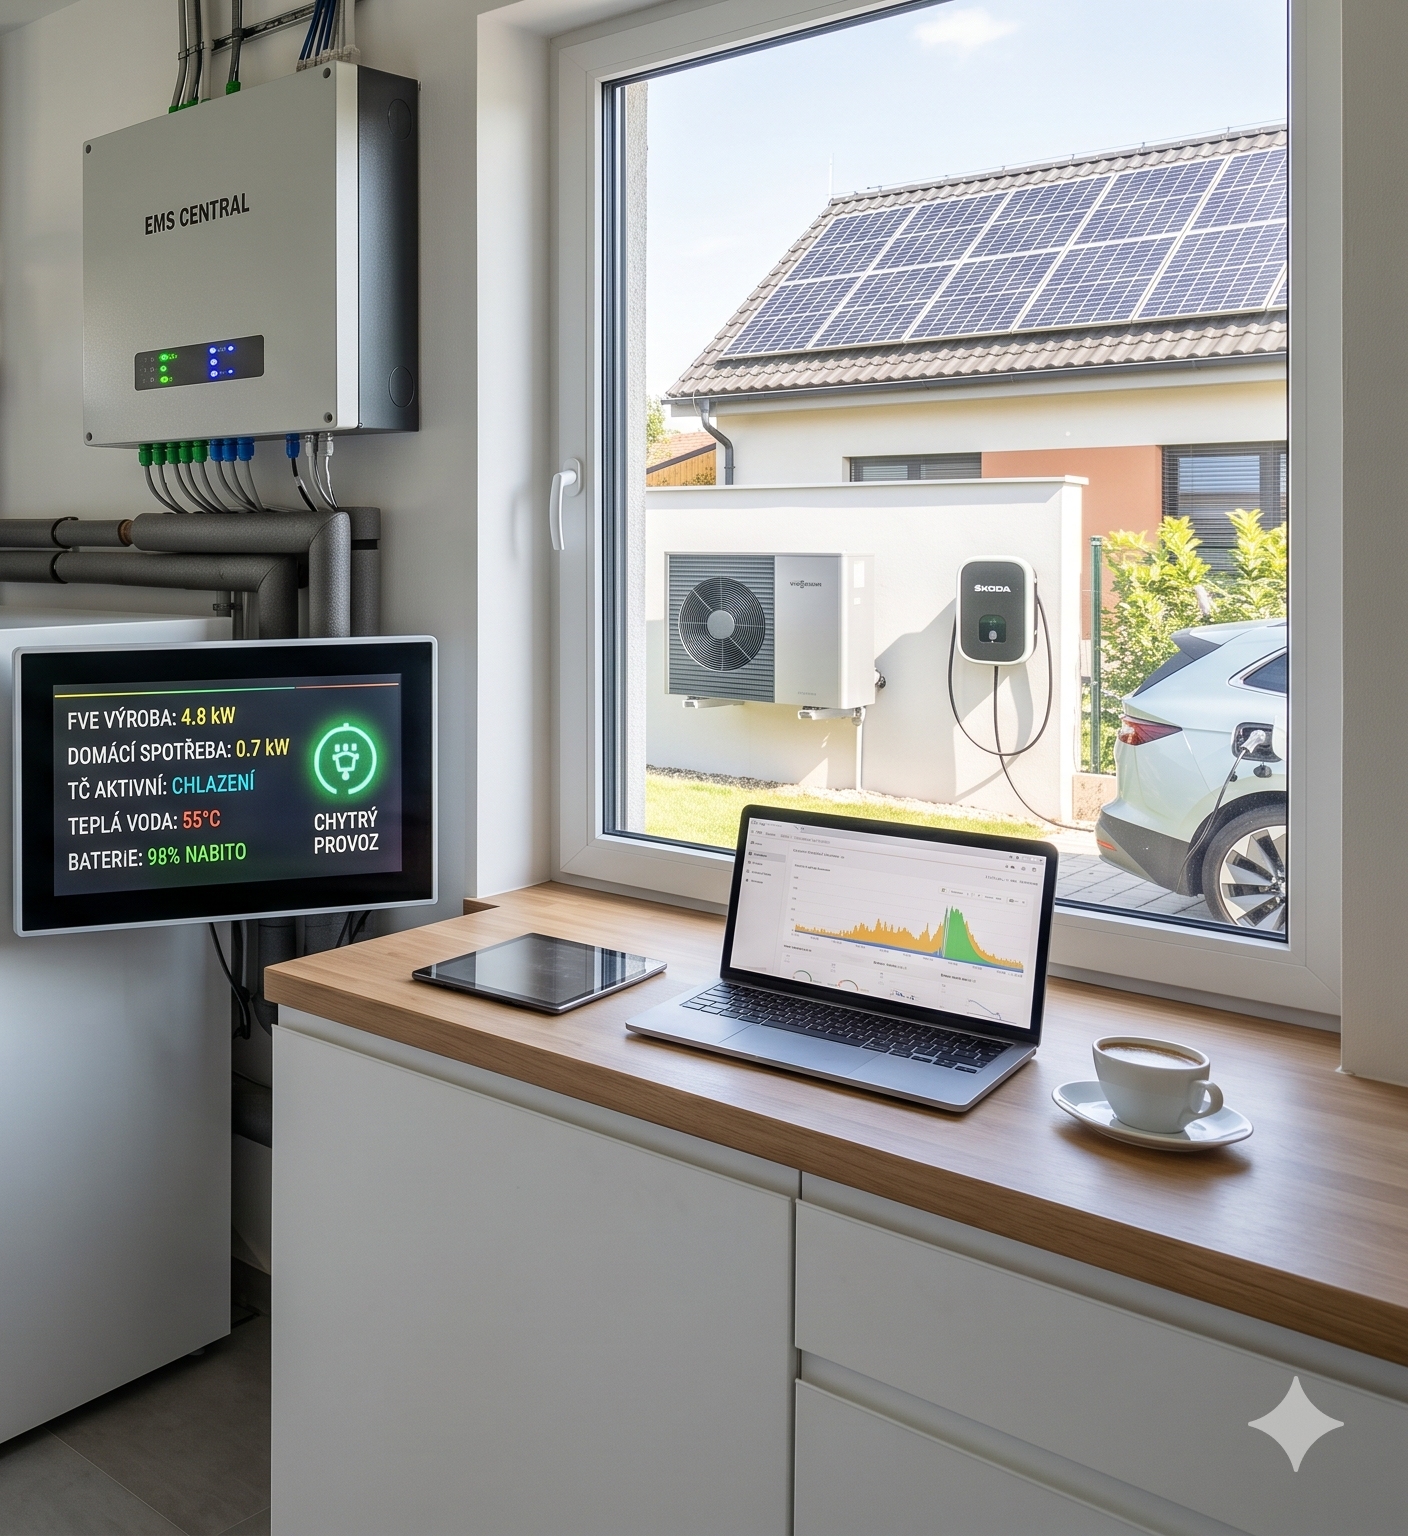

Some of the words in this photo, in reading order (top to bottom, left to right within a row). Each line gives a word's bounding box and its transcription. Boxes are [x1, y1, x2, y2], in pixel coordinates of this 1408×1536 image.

[144, 210, 175, 235] EMS
[180, 192, 250, 227] CENTRAL
[68, 712, 99, 730] FVE
[104, 707, 176, 728] VÝROBA:
[181, 707, 206, 725] 4.8
[212, 706, 235, 724] kW
[69, 741, 136, 765] DOMÁCÍ
[140, 739, 231, 761] SPOTŘEBA:
[237, 740, 260, 757] 0.7
[266, 738, 289, 756] kW
[68, 777, 90, 799] TČ
[95, 774, 166, 798] AKTIVNÍ:
[173, 769, 255, 794] CHLAZENÍ
[68, 811, 122, 835] TEPLÁ
[127, 813, 177, 831] VODA:
[183, 810, 220, 828] 55°C
[315, 806, 378, 831] CHYTRÝ
[315, 828, 378, 854] PROVOZ
[148, 847, 180, 865] 98%
[186, 843, 246, 863] NABITO
